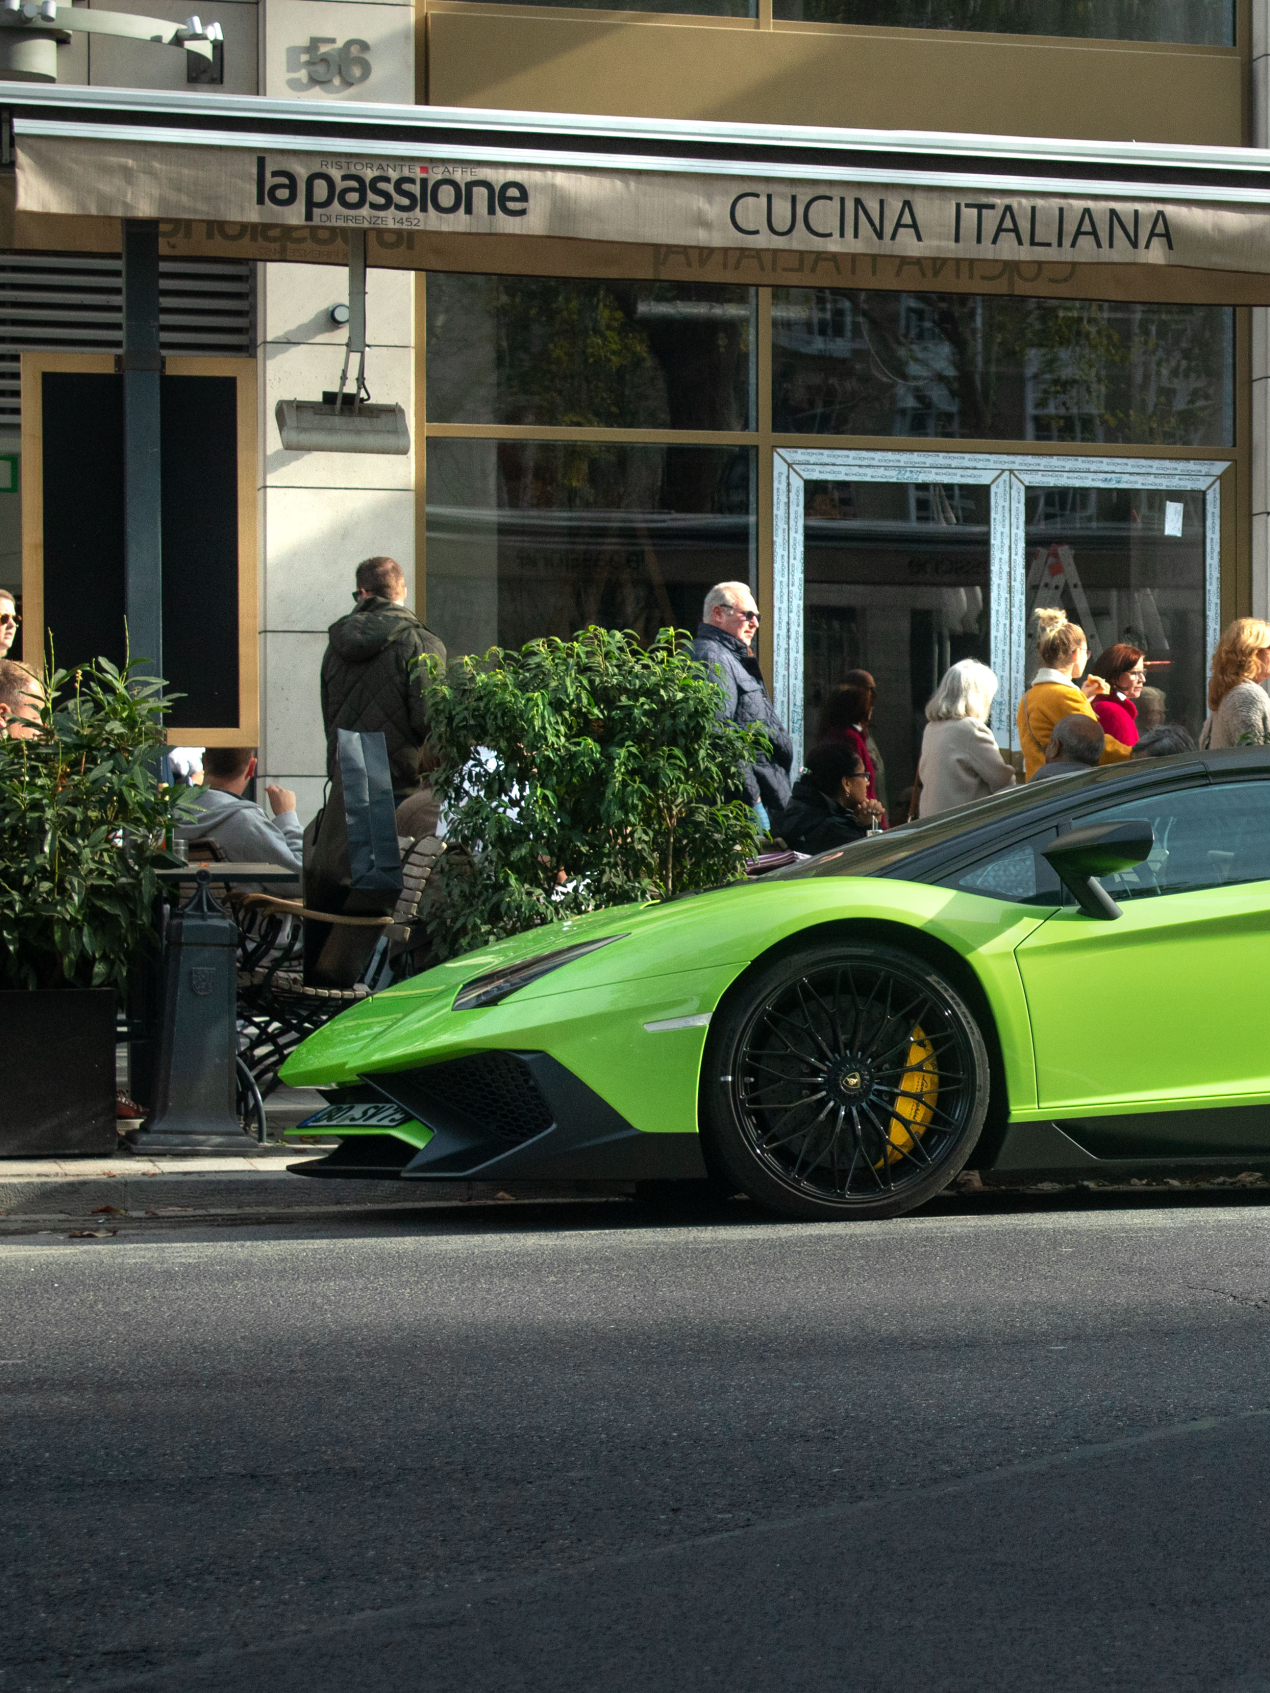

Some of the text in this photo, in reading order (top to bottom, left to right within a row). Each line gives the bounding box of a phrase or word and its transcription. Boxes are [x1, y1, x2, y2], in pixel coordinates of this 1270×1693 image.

[308, 36, 372, 85] 56
[320, 160, 416, 174] RISTORANTE
[320, 214, 420, 227] DI FIRENZE 1452
[729, 191, 1175, 251] CUCINA ITALIANA
